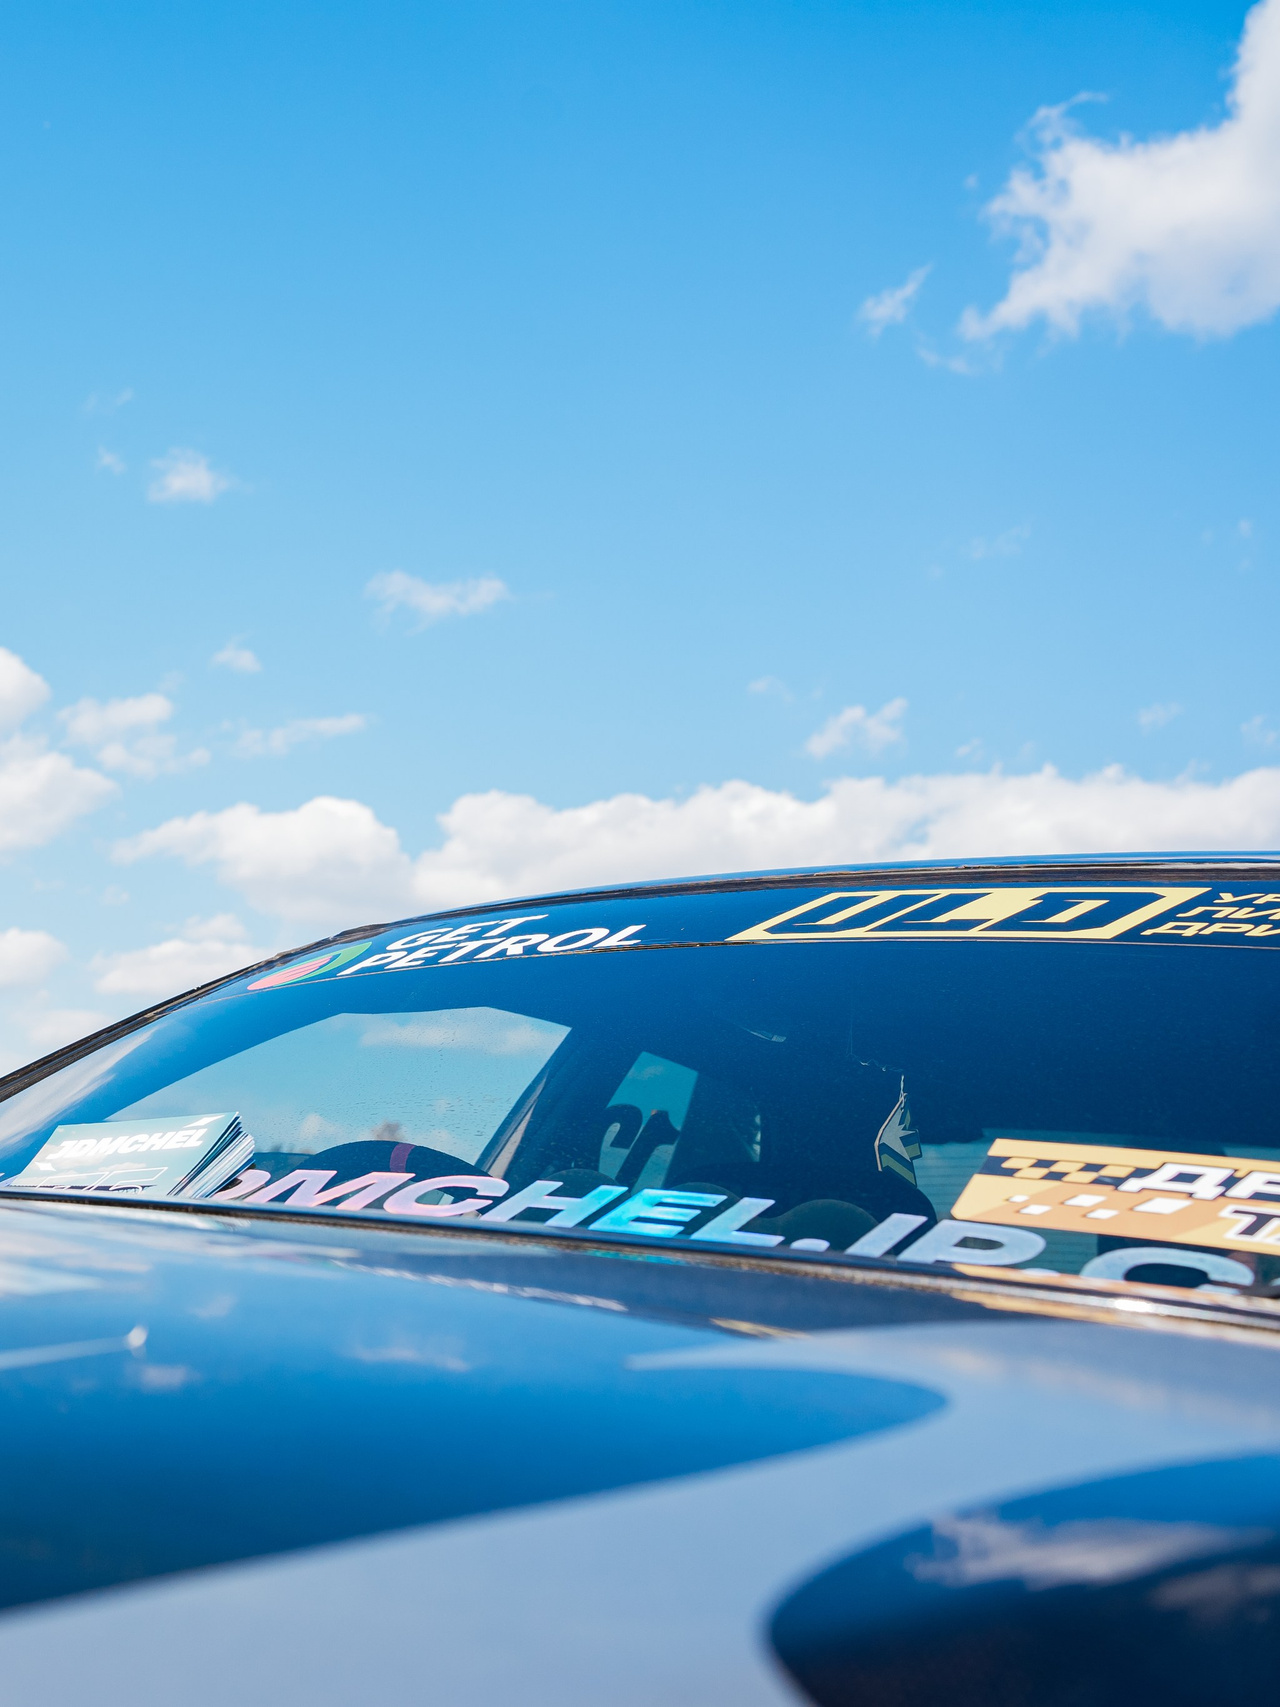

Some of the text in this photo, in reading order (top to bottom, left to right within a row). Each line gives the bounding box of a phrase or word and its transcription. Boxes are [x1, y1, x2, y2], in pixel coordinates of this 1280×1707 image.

[336, 924, 646, 976] PETROL
[387, 914, 549, 951] GET
[46, 1128, 208, 1160] JDMCHEL
